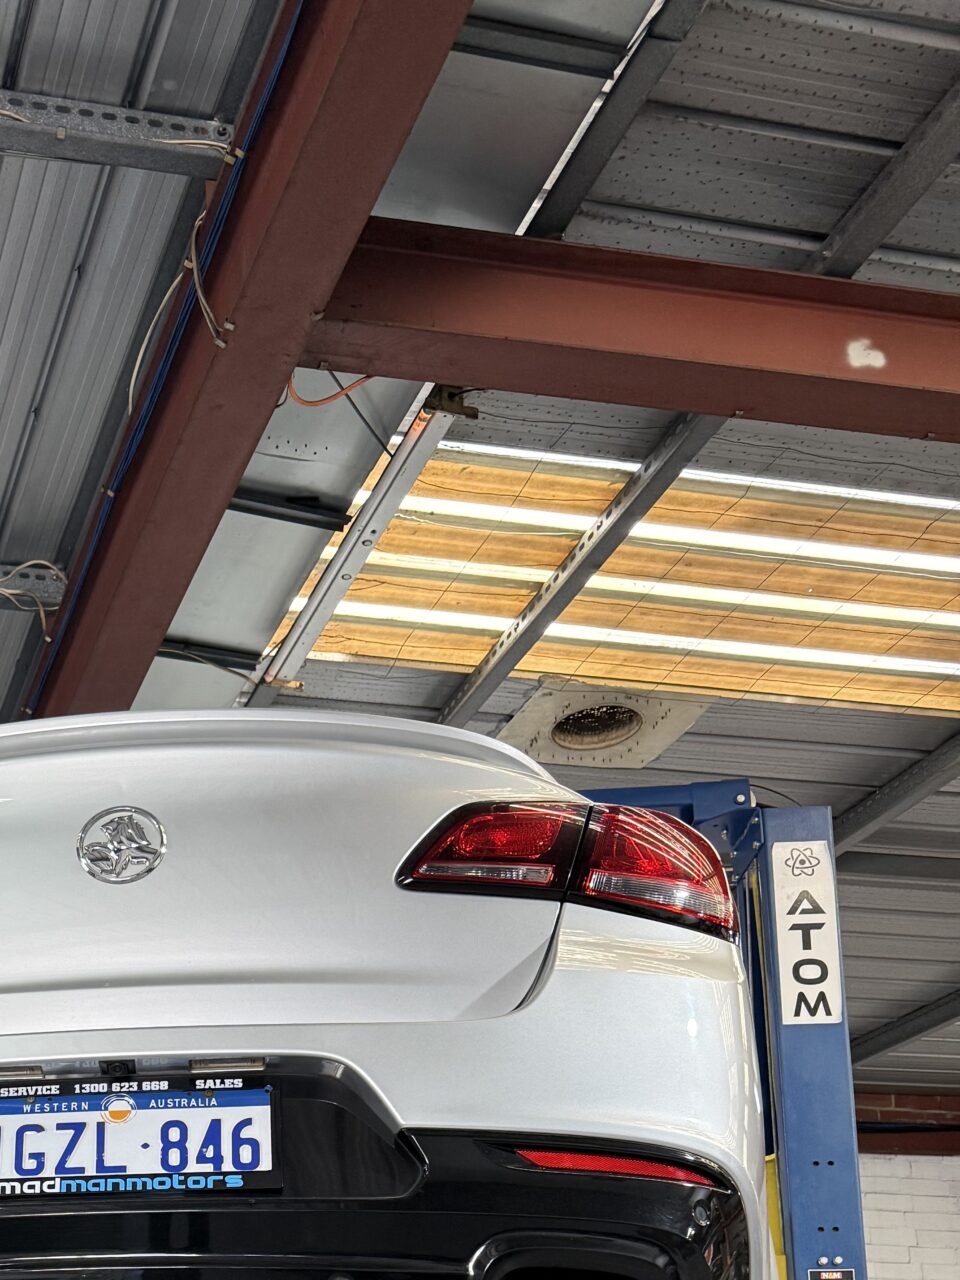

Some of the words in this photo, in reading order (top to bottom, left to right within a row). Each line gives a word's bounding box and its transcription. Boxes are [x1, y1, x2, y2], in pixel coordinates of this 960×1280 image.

[786, 890, 832, 1018] ATOM
[0, 1085, 60, 1097] SERVICE
[74, 1083, 108, 1094] 1300
[112, 1081, 139, 1092] 623
[142, 1080, 169, 1091] 668
[195, 1078, 243, 1089] SALES
[23, 1102, 89, 1113] WESTERN
[149, 1097, 218, 1108] AUSTRALIA
[160, 1117, 260, 1173] 846
